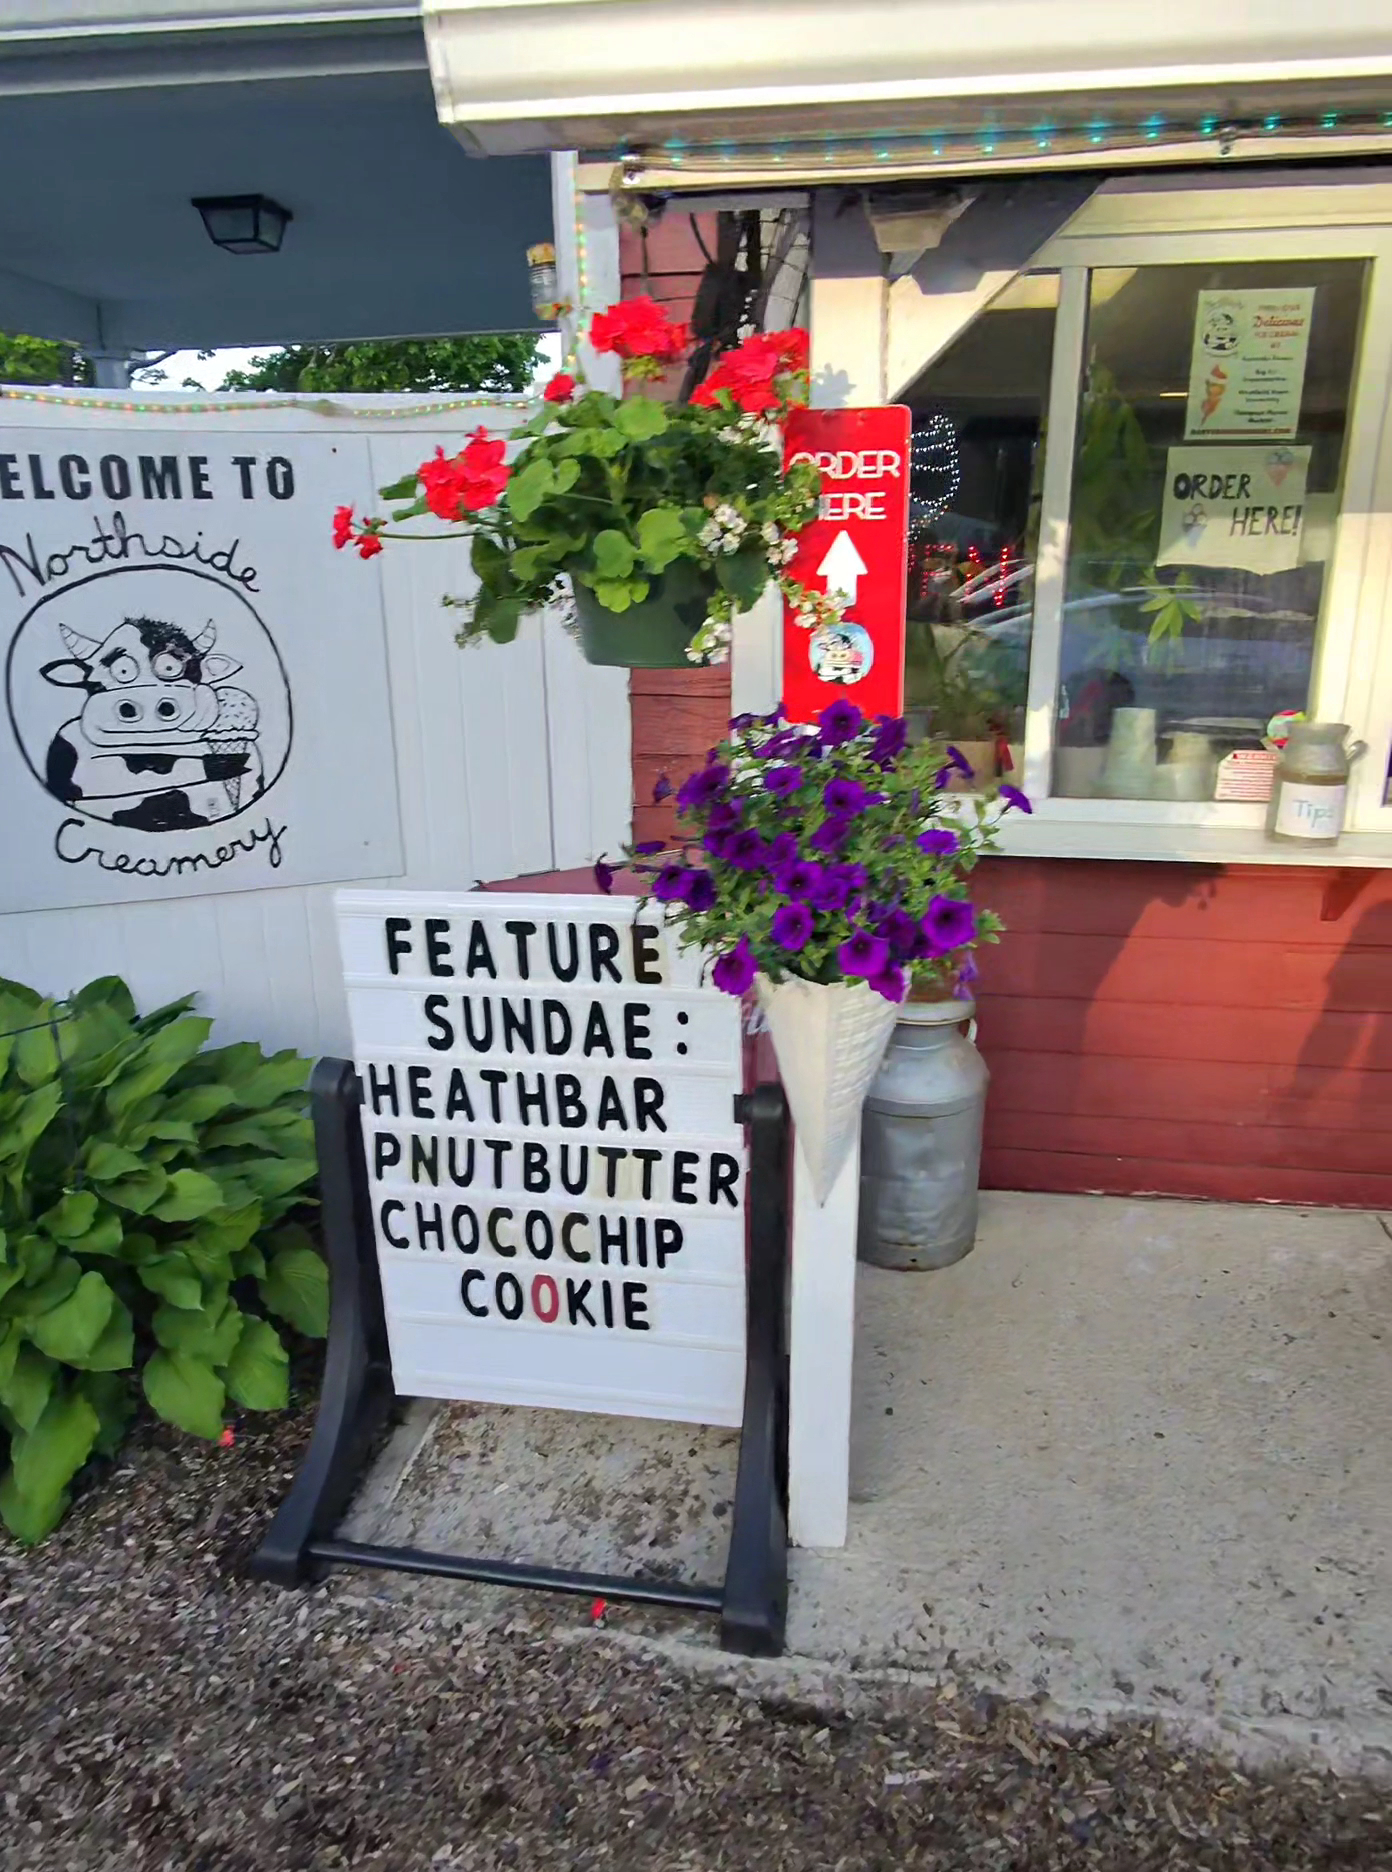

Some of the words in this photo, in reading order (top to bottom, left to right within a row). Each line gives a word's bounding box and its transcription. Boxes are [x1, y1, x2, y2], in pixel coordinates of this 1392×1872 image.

[231, 456, 295, 500] TO
[818, 491, 887, 521] ERE
[1173, 472, 1251, 500] ORDER
[1230, 504, 1302, 536] HERE!
[0, 511, 260, 598] Northside
[55, 817, 288, 877] Creamery
[385, 917, 662, 985] FEATURE
[368, 1063, 668, 1133] HEATHBAR
[374, 1132, 740, 1208] PNUTBUTTER
[380, 1198, 684, 1269] CHOCOCHIP
[460, 1268, 651, 1331] COOKIE
